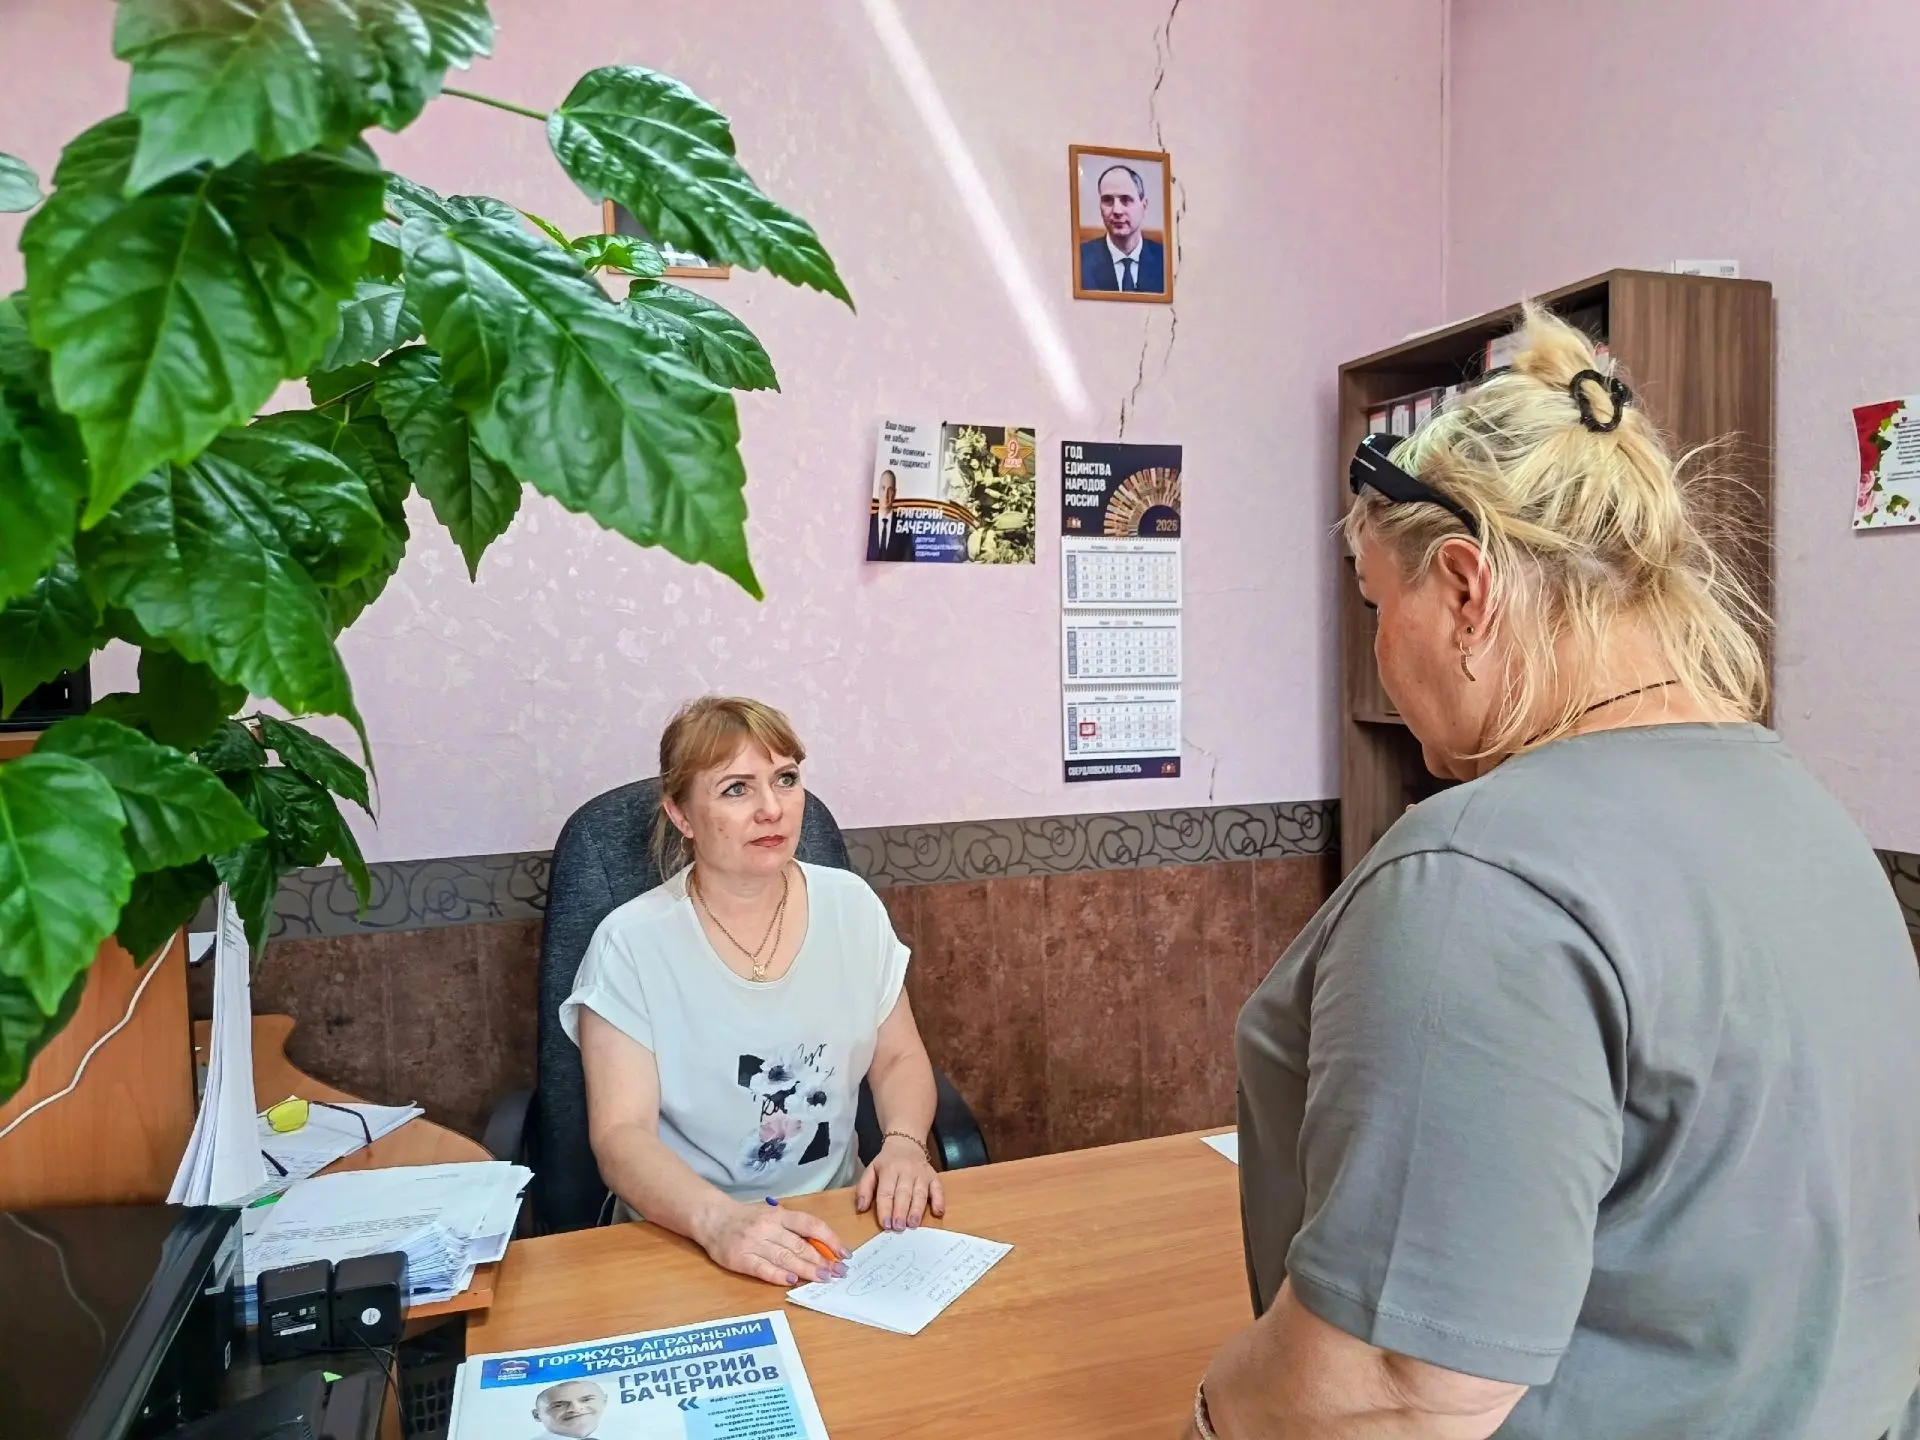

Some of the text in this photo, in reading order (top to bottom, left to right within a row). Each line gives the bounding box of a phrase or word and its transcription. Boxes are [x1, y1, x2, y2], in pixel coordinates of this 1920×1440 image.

[1008, 438, 1018, 458] 9
[1065, 446, 1083, 460] ГОД
[1065, 462, 1112, 476] ЕДИНСТВА
[1065, 478, 1106, 492] НАРОДОВ
[1065, 494, 1099, 507] РОССИИ
[896, 505, 944, 520] ГРИГОРИЙ
[895, 520, 966, 536] БАЧЕРИКОВ
[1156, 518, 1178, 532] 2026
[538, 1322, 762, 1368] ГОРЖУСЬ АГРАРНЫМИ
[585, 1340, 724, 1372] ТРАДИЦИЯМИ
[619, 1352, 756, 1389] ГРИГОРИЙ
[620, 1366, 780, 1404] БАЧЕРИКОВ
